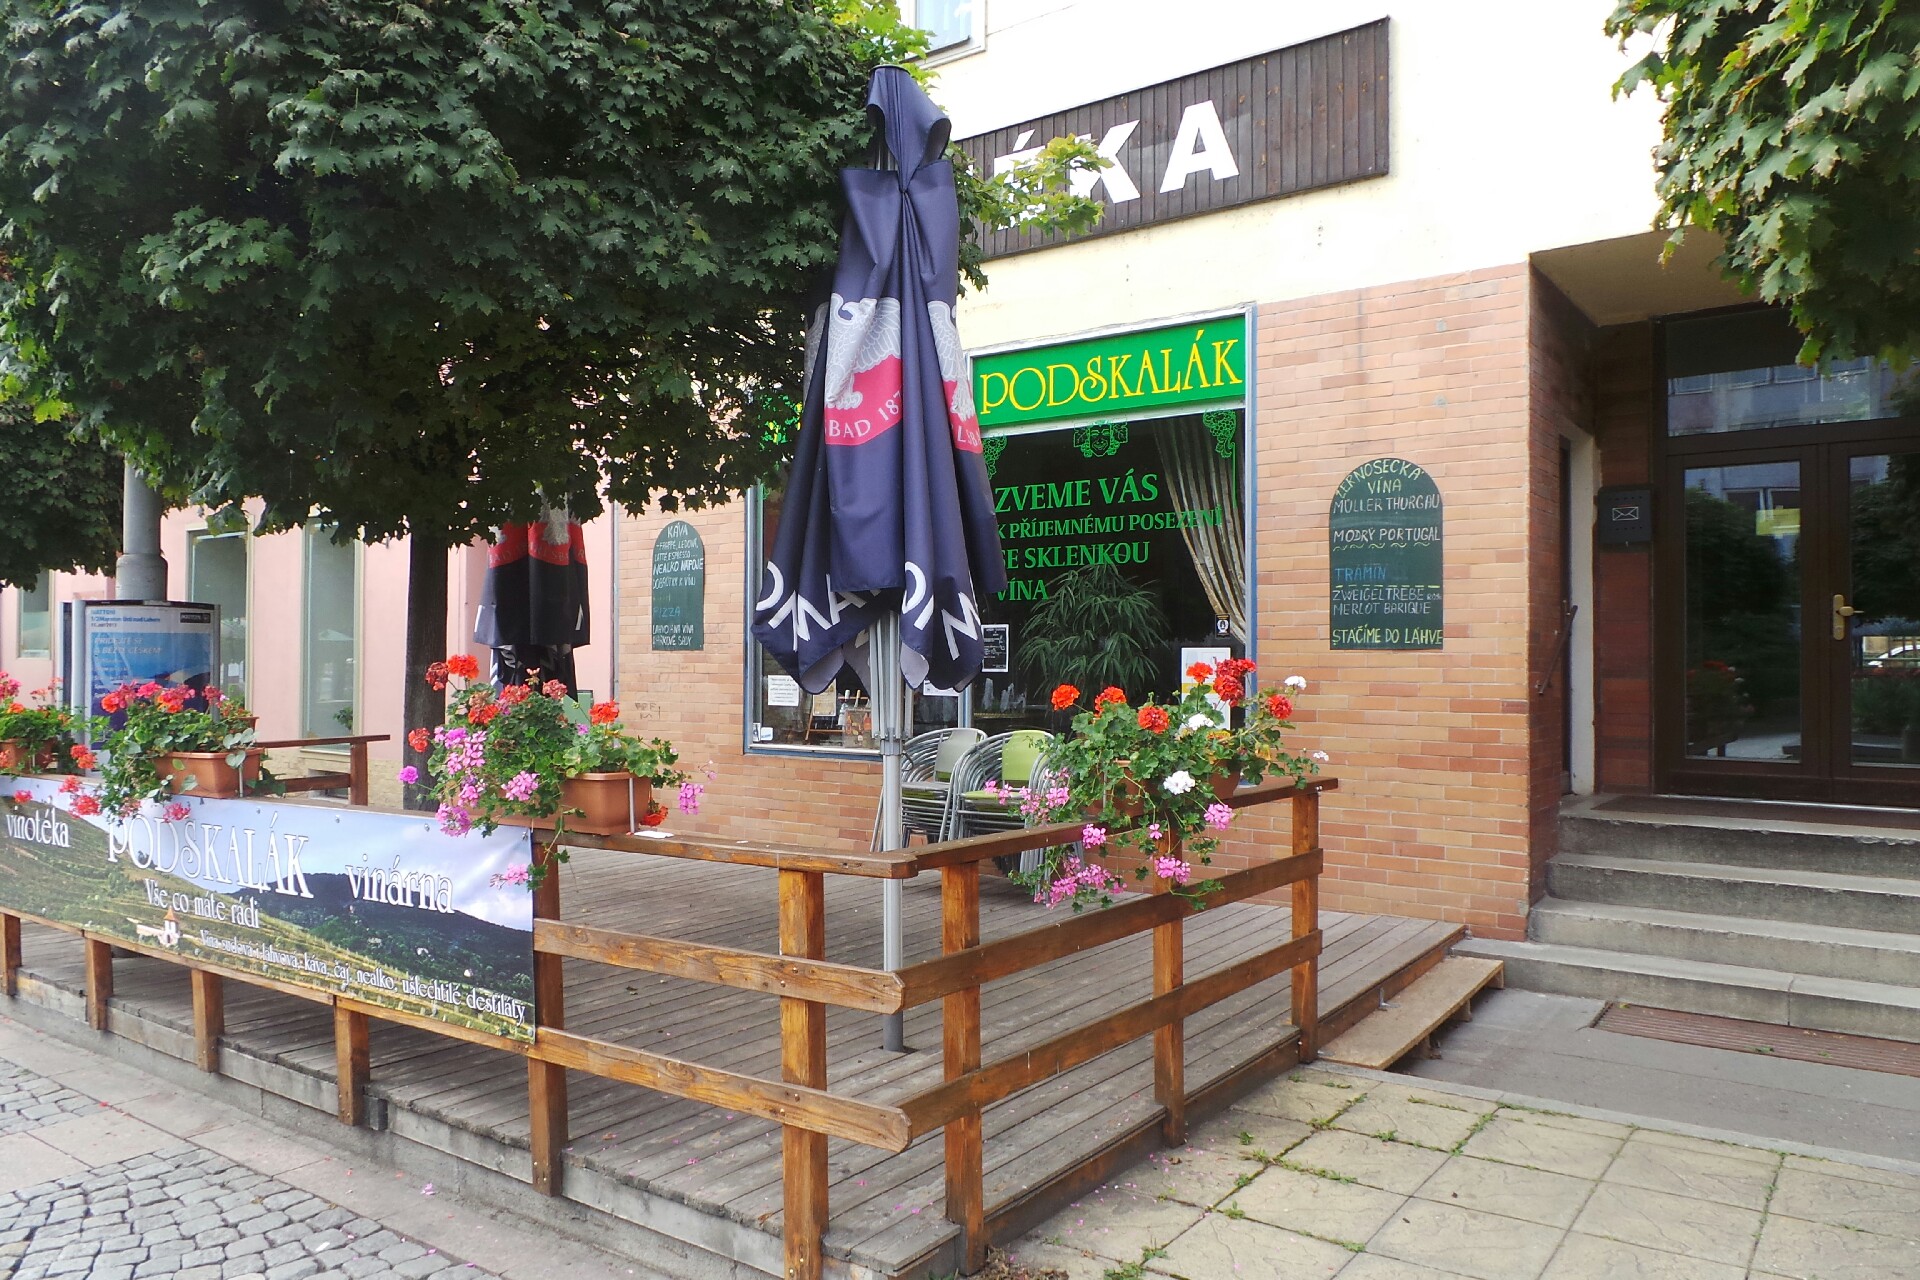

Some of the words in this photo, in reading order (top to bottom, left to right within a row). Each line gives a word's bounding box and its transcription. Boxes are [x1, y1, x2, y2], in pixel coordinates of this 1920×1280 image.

[980, 330, 1243, 415] PODSKALÁK
[825, 418, 871, 438] BAD
[994, 479, 1091, 513] ZVEME
[1098, 468, 1159, 504] VÁS
[1367, 477, 1402, 494] VÍNA
[1386, 494, 1440, 510] THURGAU
[1009, 513, 1124, 539] PŘÍJEMNÉMU
[1379, 526, 1441, 541] PORTUGAL
[1024, 541, 1150, 569] SKLENKOU
[1333, 602, 1380, 615] MERLOT
[1385, 628, 1400, 643] DO
[6, 804, 71, 848] vinotéka
[107, 811, 315, 899] PODSKALÁK
[345, 854, 455, 914] vinárna
[144, 878, 168, 908] Vše
[172, 892, 189, 913] co
[194, 889, 226, 921] máte
[231, 896, 260, 928] rádi
[402, 975, 462, 1006] ušlechtilé
[466, 987, 526, 1026] destiláty
